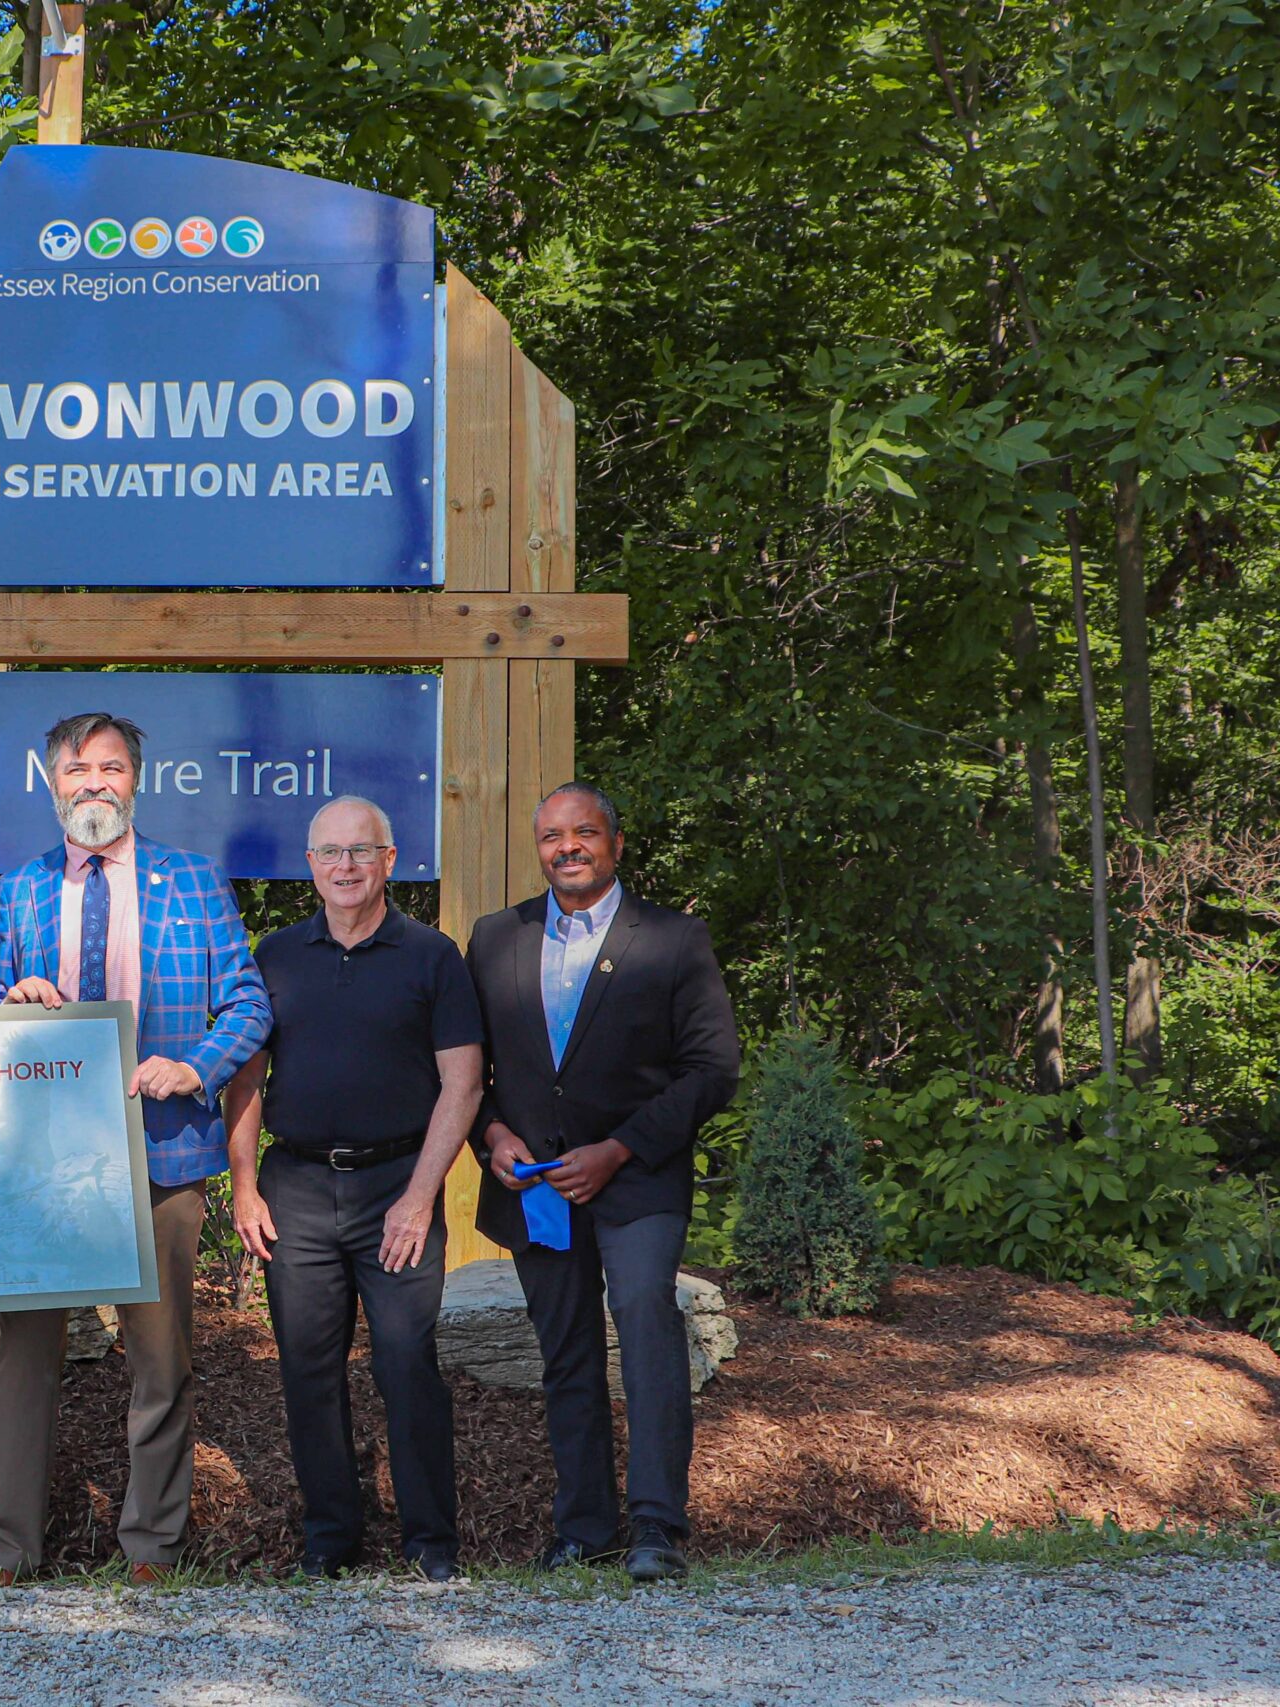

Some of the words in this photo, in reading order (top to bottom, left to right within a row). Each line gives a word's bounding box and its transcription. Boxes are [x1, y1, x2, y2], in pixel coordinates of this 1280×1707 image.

[62, 272, 147, 302] Region
[152, 269, 320, 295] Conservation
[269, 462, 393, 497] AREA
[25, 749, 203, 796] Nre
[219, 748, 333, 797] Trail
